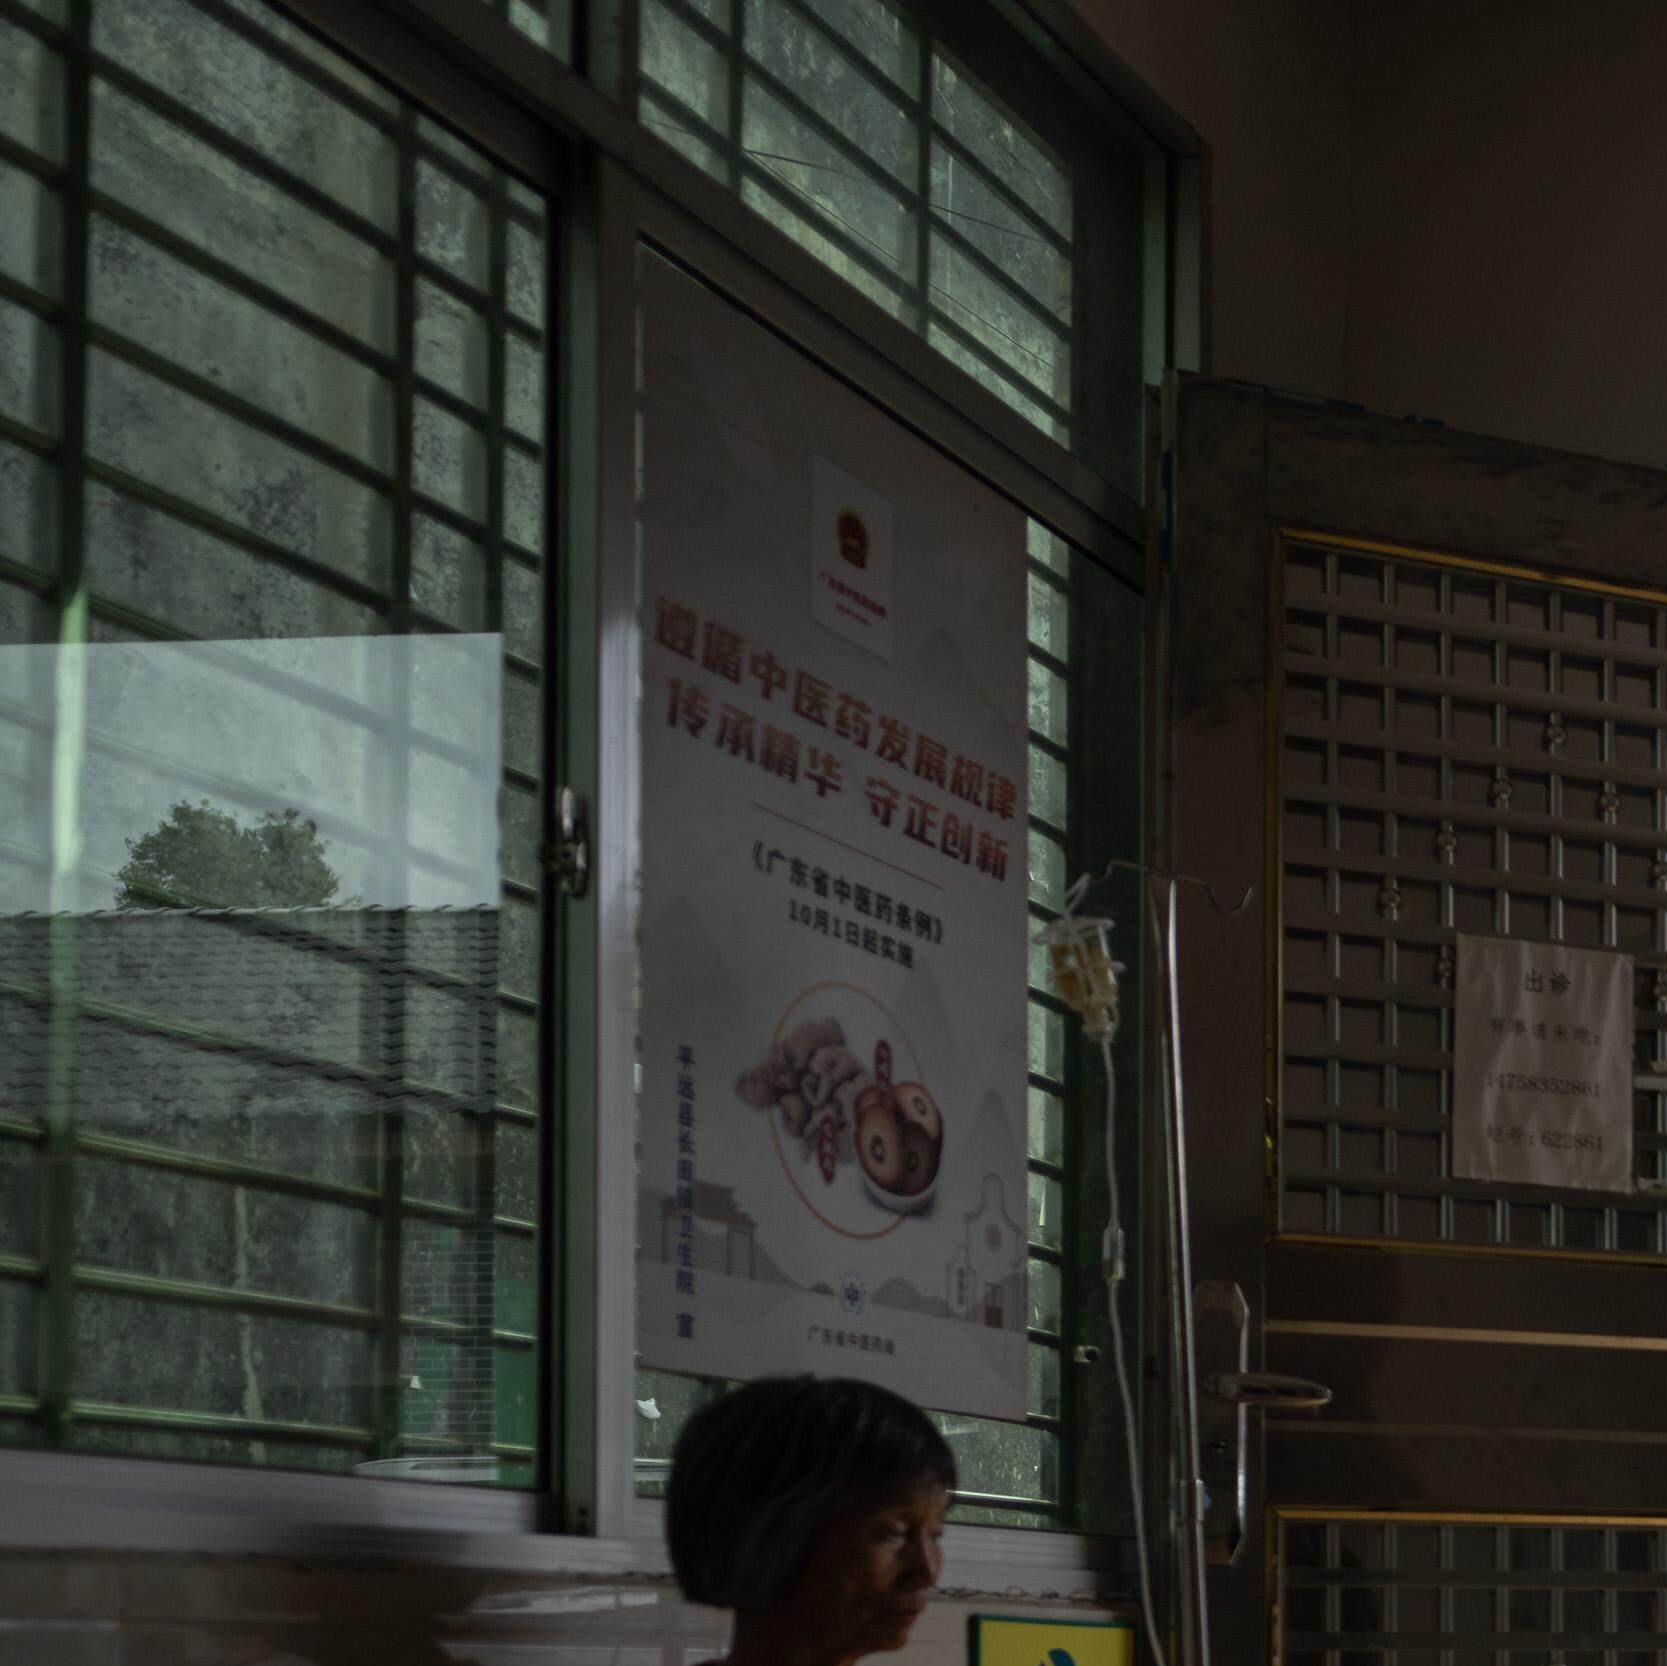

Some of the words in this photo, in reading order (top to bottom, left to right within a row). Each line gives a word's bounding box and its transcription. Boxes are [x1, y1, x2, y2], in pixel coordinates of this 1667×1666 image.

[653, 597, 1018, 822] 遵循中医药发展规律
[665, 676, 843, 798] 传承精华
[864, 773, 1009, 882] 守正创新
[752, 841, 944, 946] 《广东省中医药条例》
[1524, 968, 1571, 995] 出诊
